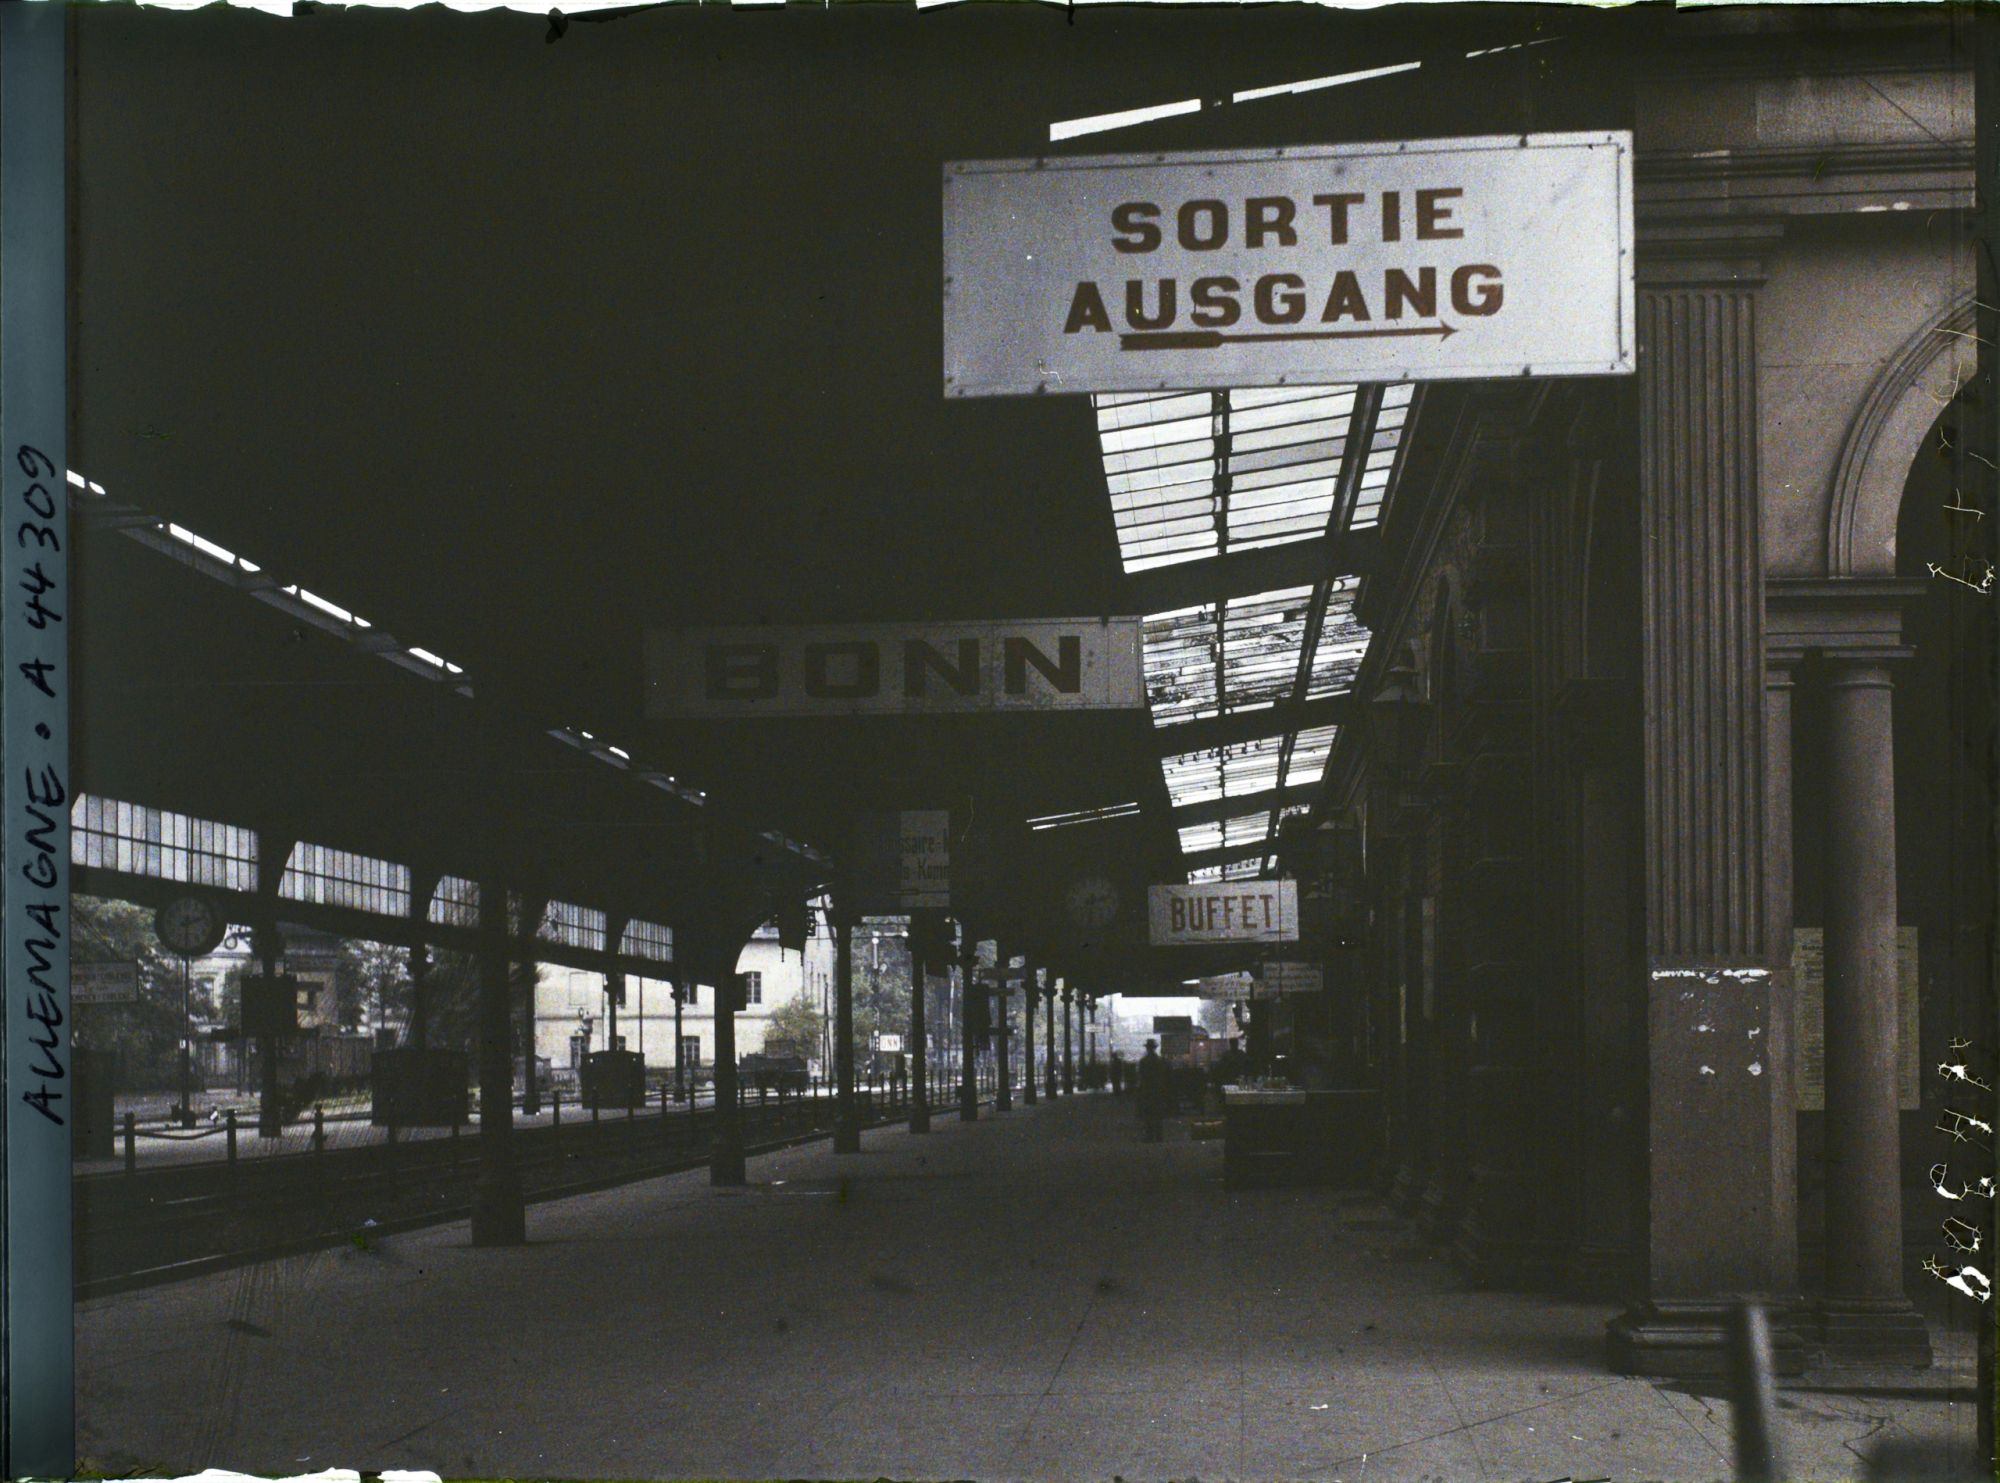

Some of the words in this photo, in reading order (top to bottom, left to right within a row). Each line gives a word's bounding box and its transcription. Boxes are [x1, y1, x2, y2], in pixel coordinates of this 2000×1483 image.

[1111, 187, 1464, 254] SORTIE
[1063, 263, 1505, 334] AUSGANG
[704, 634, 1082, 701] BONN
[1170, 893, 1274, 933] BUFFET
